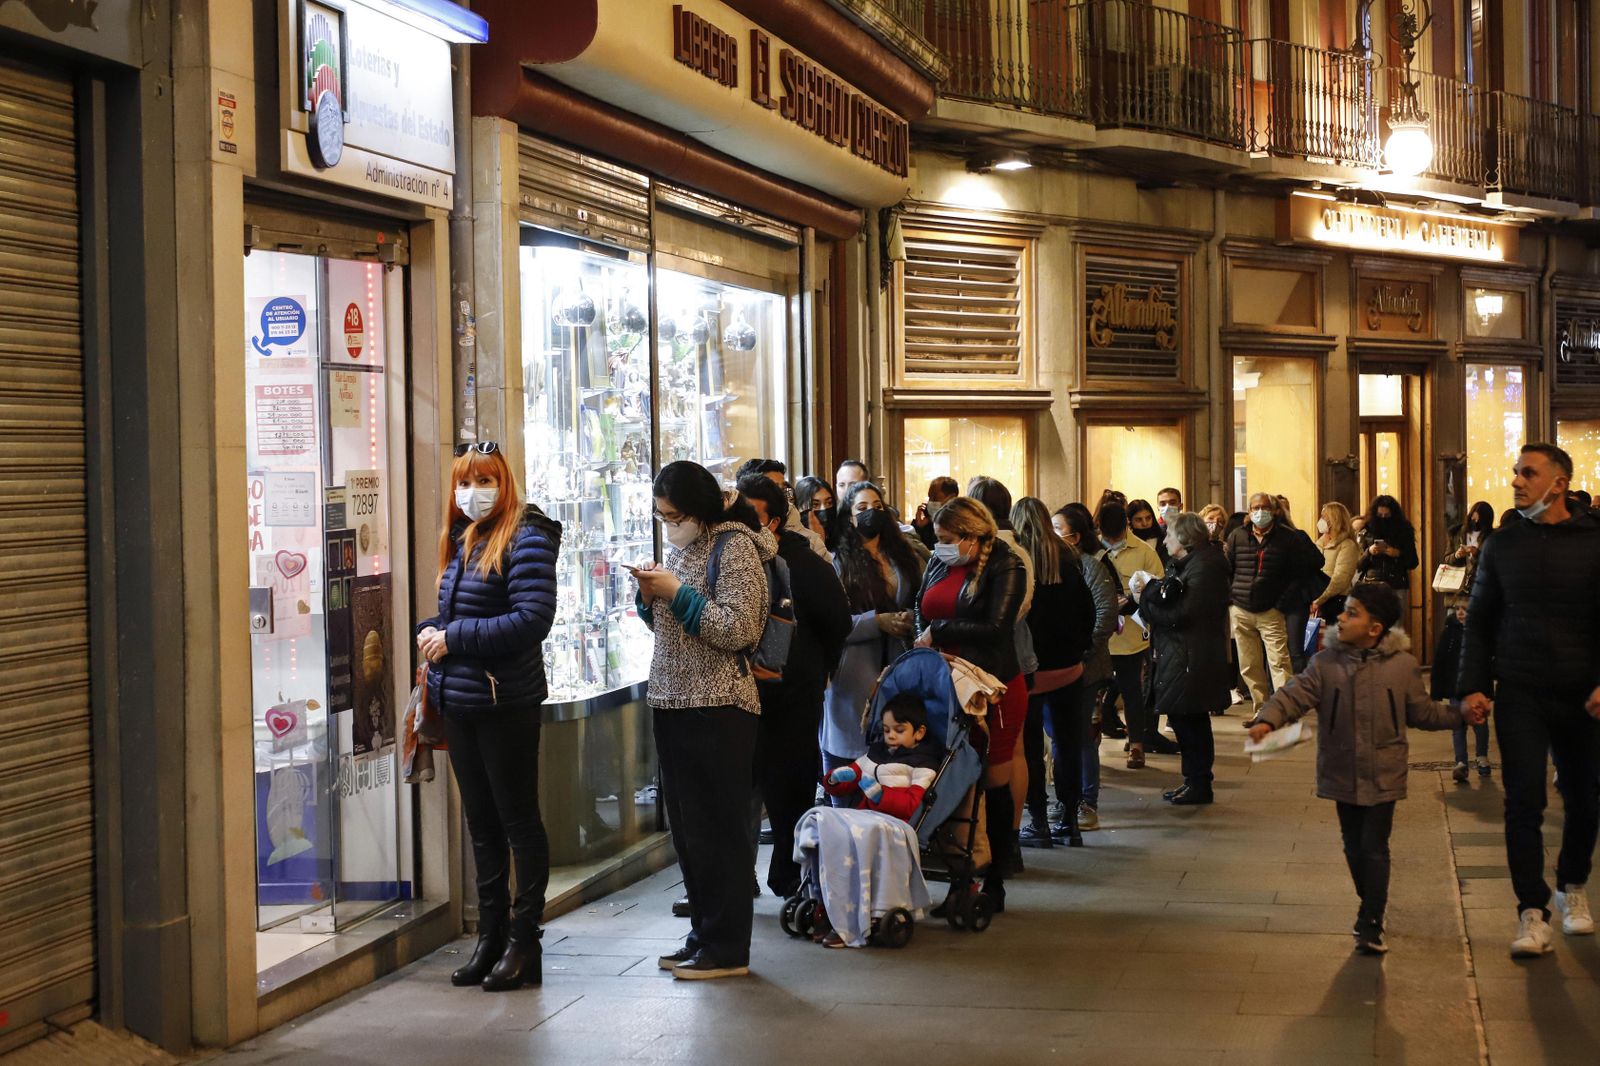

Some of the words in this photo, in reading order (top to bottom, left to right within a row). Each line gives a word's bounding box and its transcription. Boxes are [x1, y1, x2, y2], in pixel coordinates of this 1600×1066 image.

[394, 62, 400, 88] y
[402, 108, 416, 137] del
[418, 115, 450, 147] Estado
[365, 161, 428, 196] Administración
[442, 182, 449, 200] 4
[346, 307, 359, 326] +18
[264, 386, 304, 395] BOTES
[356, 476, 380, 489] PREMIO
[352, 493, 379, 516] 72897
